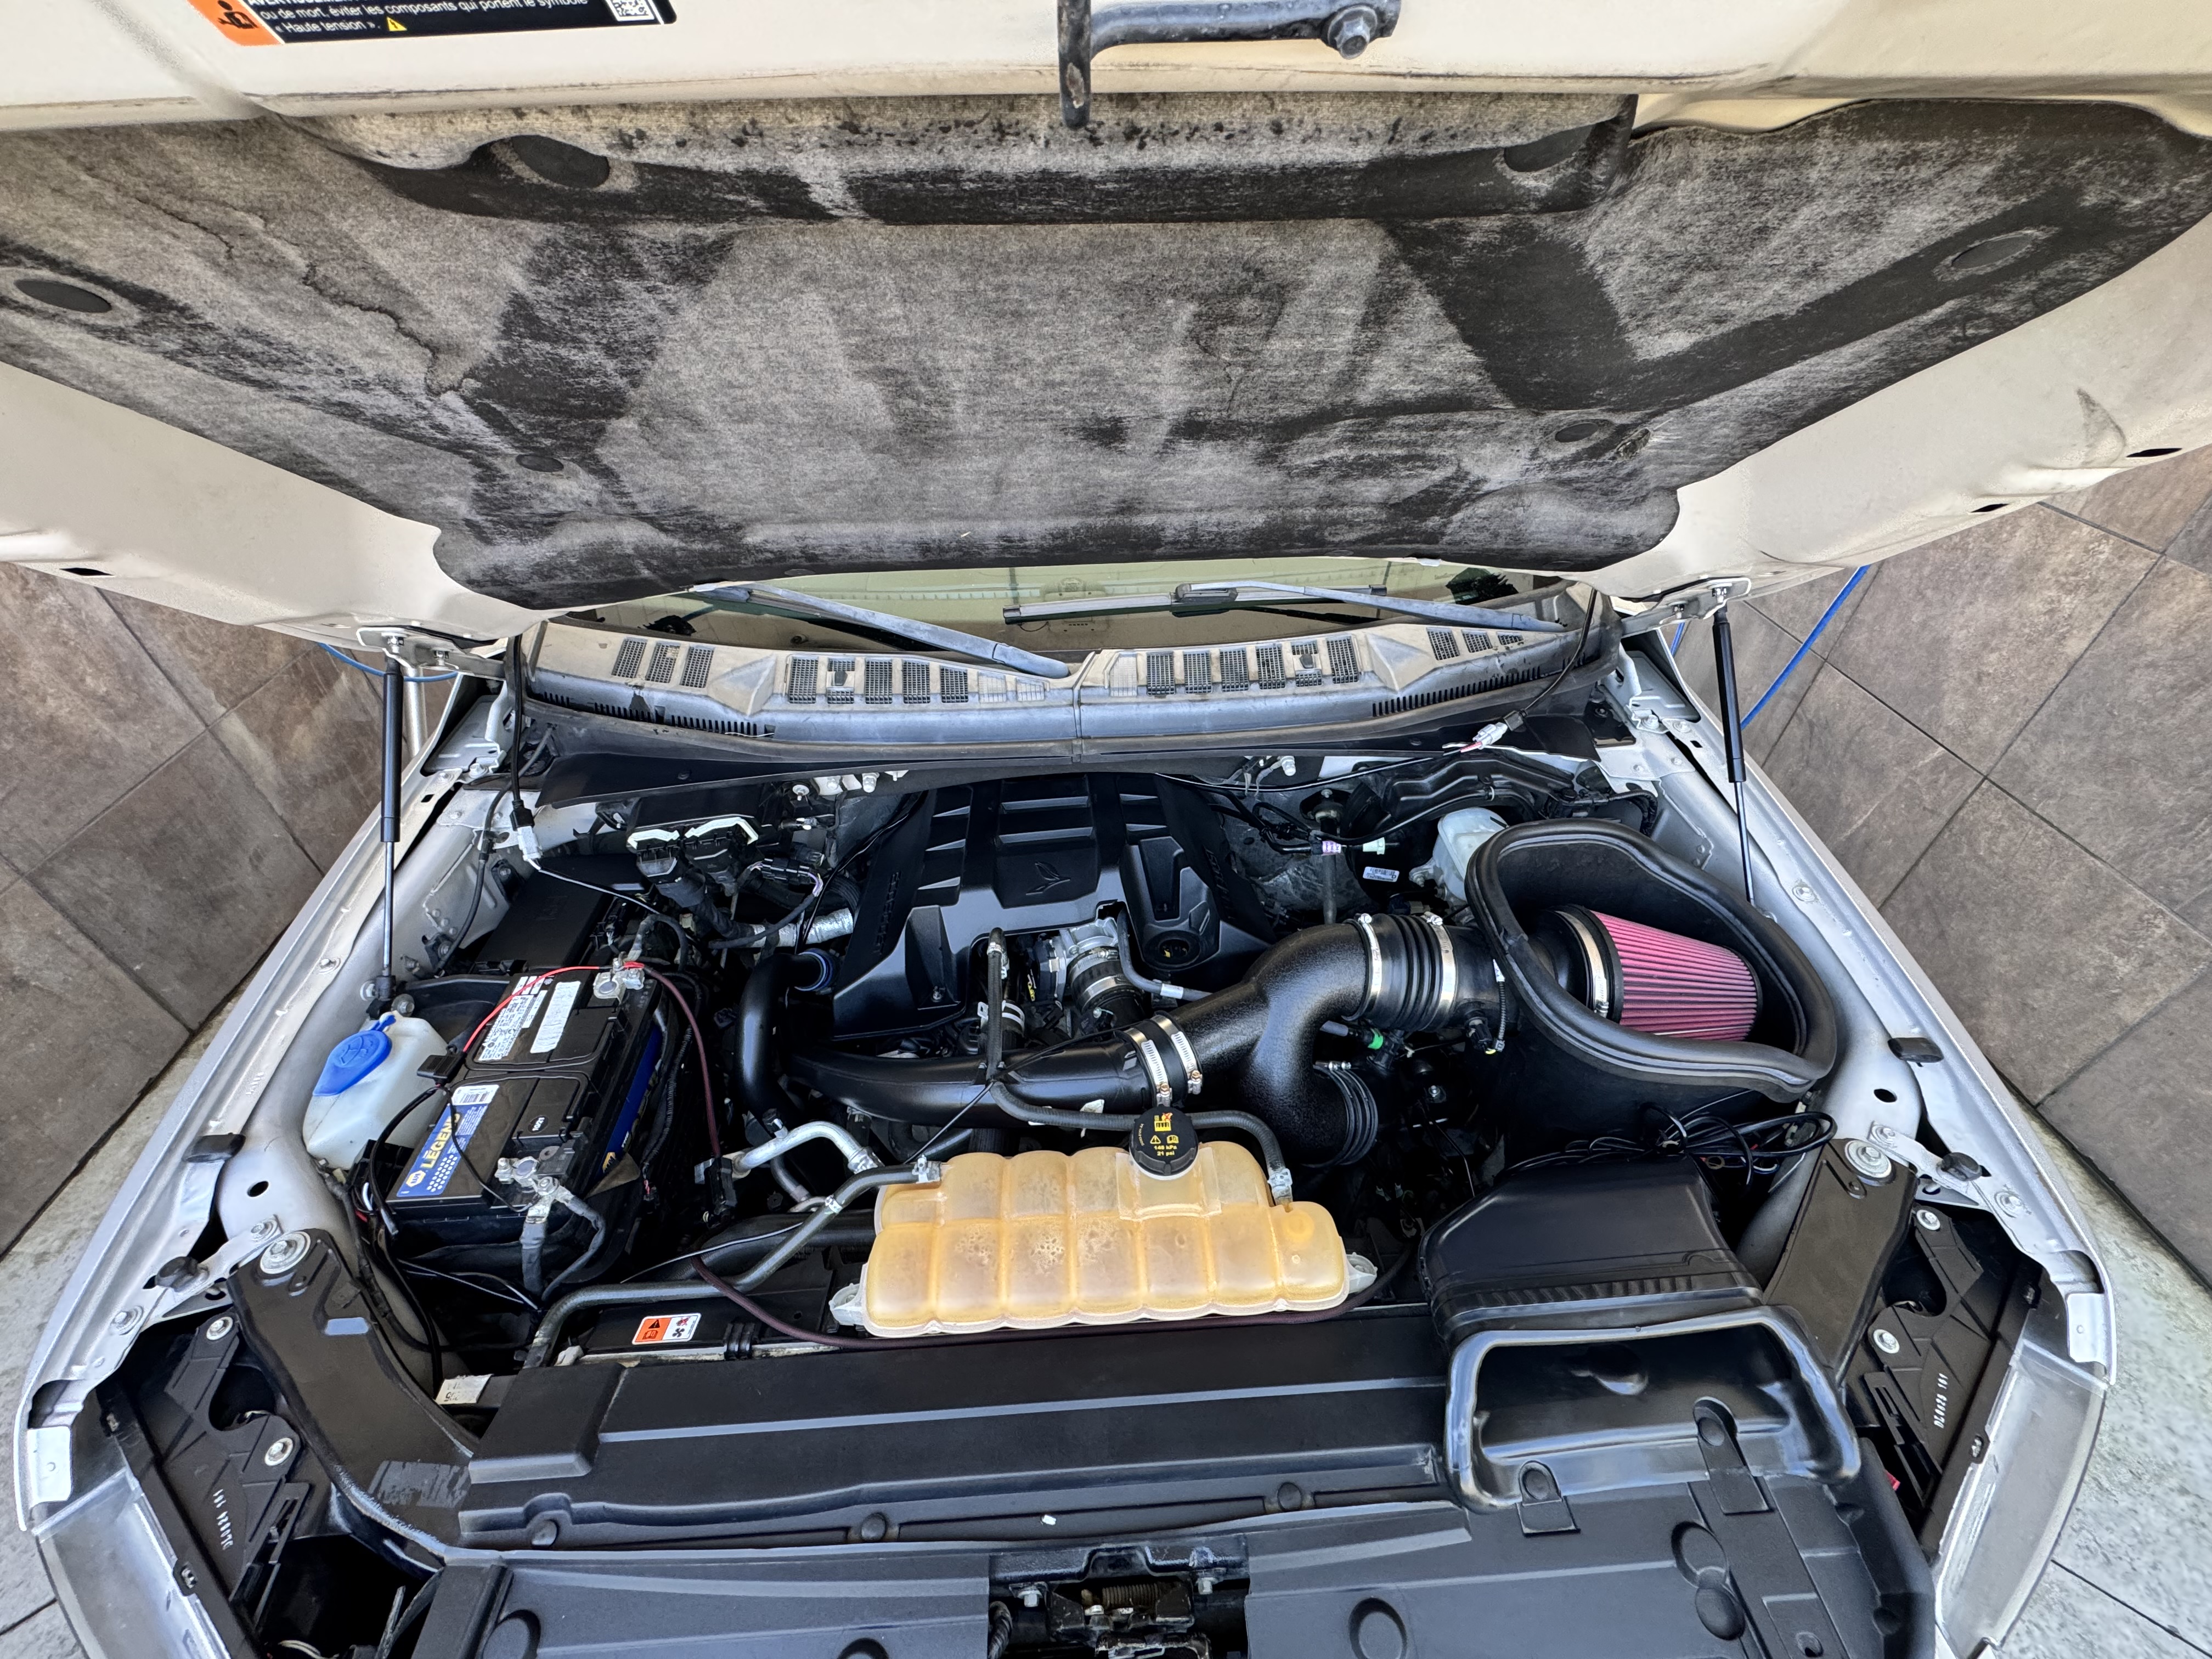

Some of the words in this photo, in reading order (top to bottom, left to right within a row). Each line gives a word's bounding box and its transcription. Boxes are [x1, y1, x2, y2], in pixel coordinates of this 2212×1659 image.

[260, 11, 279, 20] ou
[278, 8, 296, 19] de
[329, 5, 363, 16] éviter
[362, 4, 385, 15] les
[385, 2, 458, 15] composants
[458, 1, 479, 13] qui
[481, 0, 523, 12] portent
[282, 22, 320, 33] Haute
[319, 20, 368, 31] tension
[532, 1117, 545, 1131] 10/21
